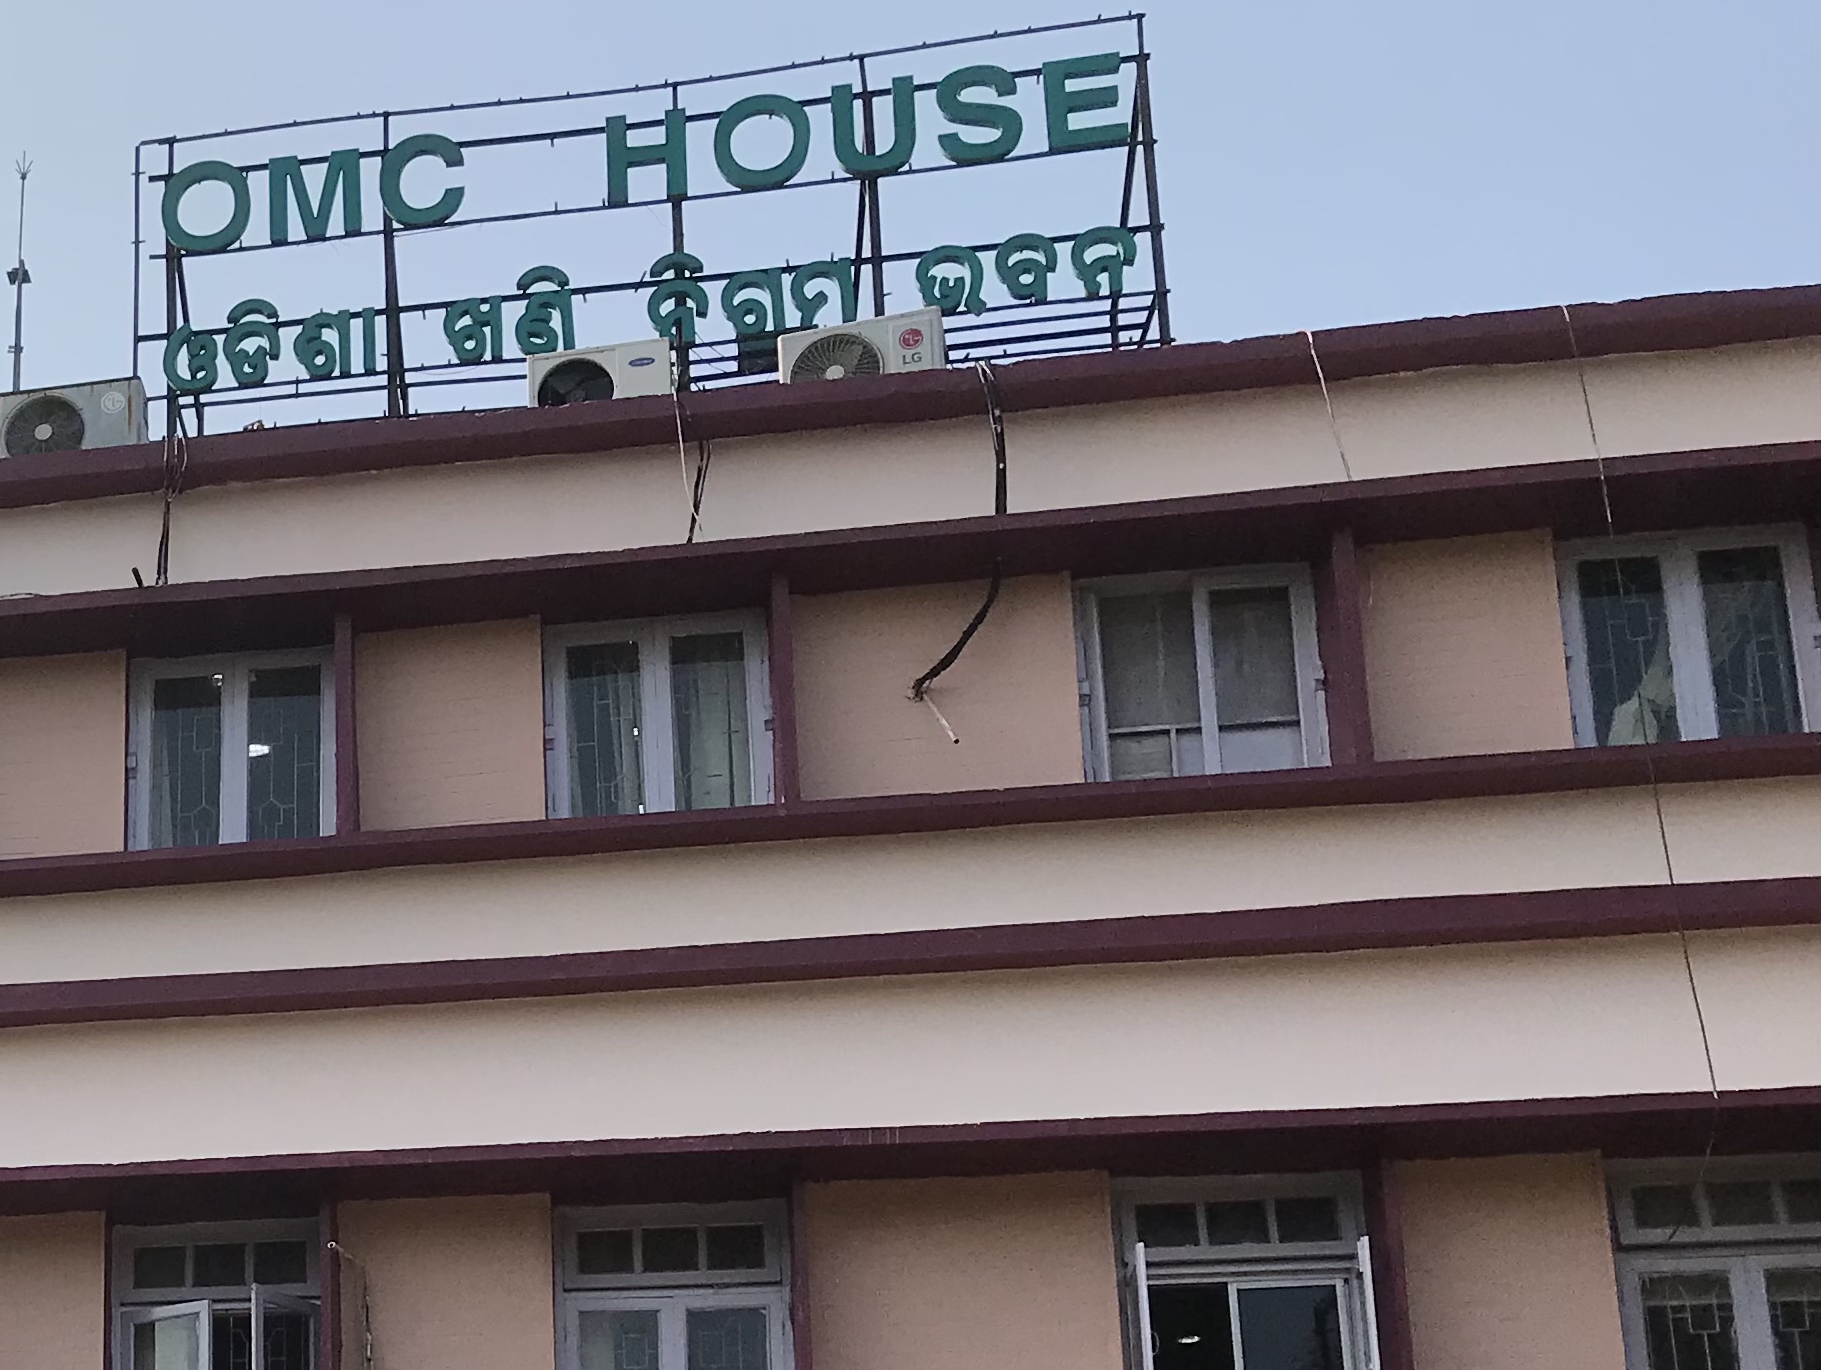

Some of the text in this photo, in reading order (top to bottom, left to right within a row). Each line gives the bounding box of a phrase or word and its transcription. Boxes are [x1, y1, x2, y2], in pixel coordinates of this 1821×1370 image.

[162, 52, 1129, 252] OMC HOUSE
[916, 226, 1138, 317] ଭବନ
[902, 351, 923, 365] LG
